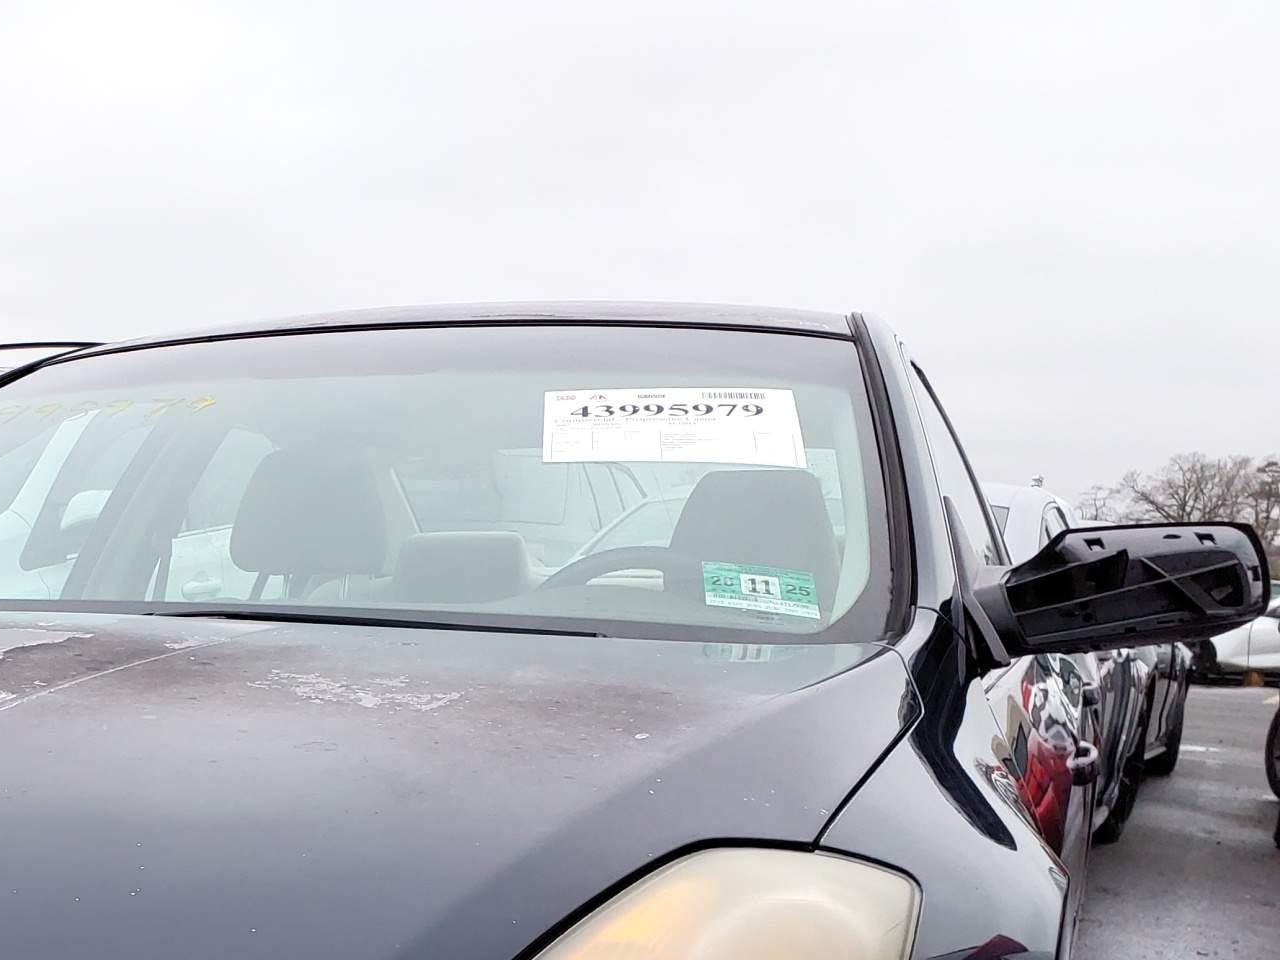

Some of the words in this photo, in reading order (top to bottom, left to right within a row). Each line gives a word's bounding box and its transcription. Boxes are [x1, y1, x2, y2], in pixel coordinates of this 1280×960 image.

[570, 402, 764, 418] 43995979
[747, 577, 774, 596] 11
[785, 583, 811, 597] 25
